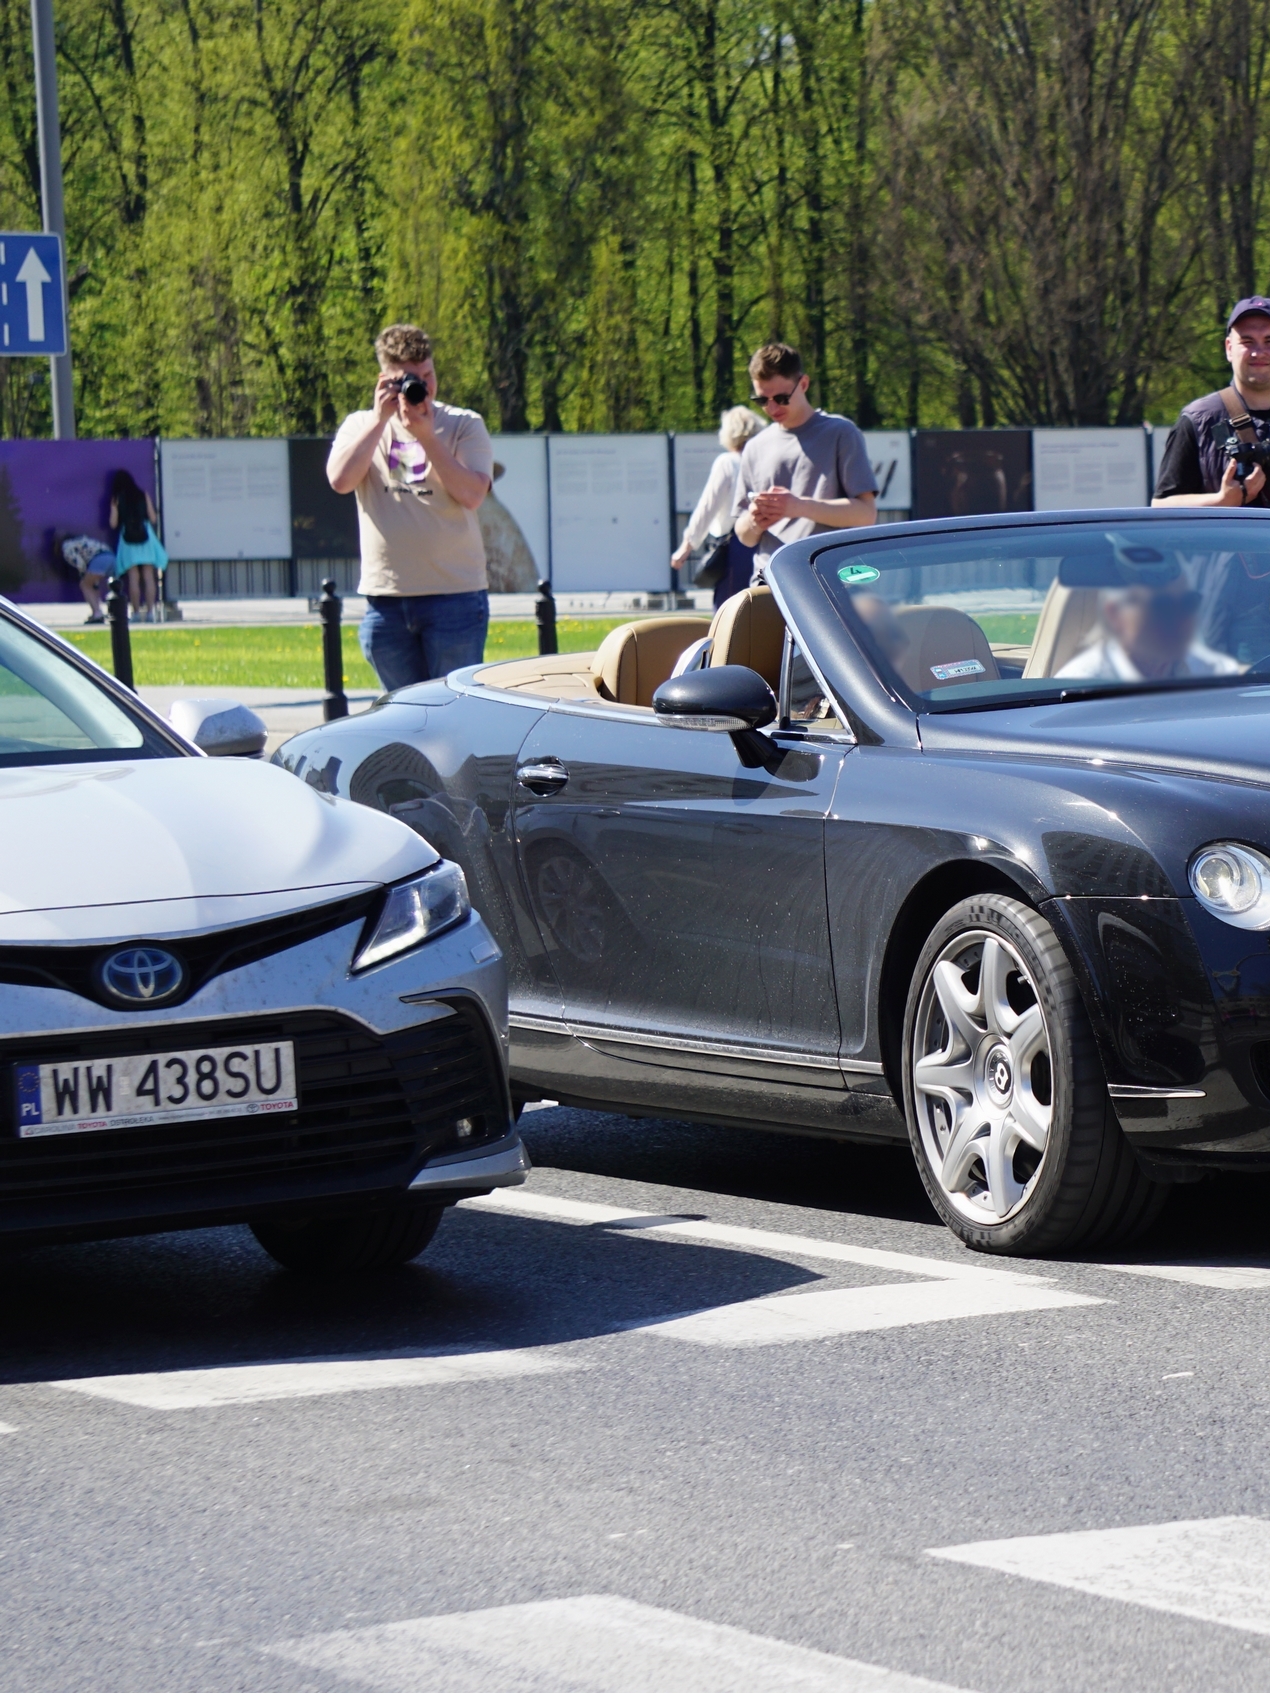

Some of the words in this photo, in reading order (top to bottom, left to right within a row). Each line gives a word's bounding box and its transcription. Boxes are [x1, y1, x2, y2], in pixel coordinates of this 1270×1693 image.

[52, 1064, 113, 1116] WW
[136, 1047, 282, 1107] 438SU
[21, 1102, 40, 1117] PL
[260, 1101, 294, 1110] TOYOTA
[77, 1121, 107, 1129] TOYOTA
